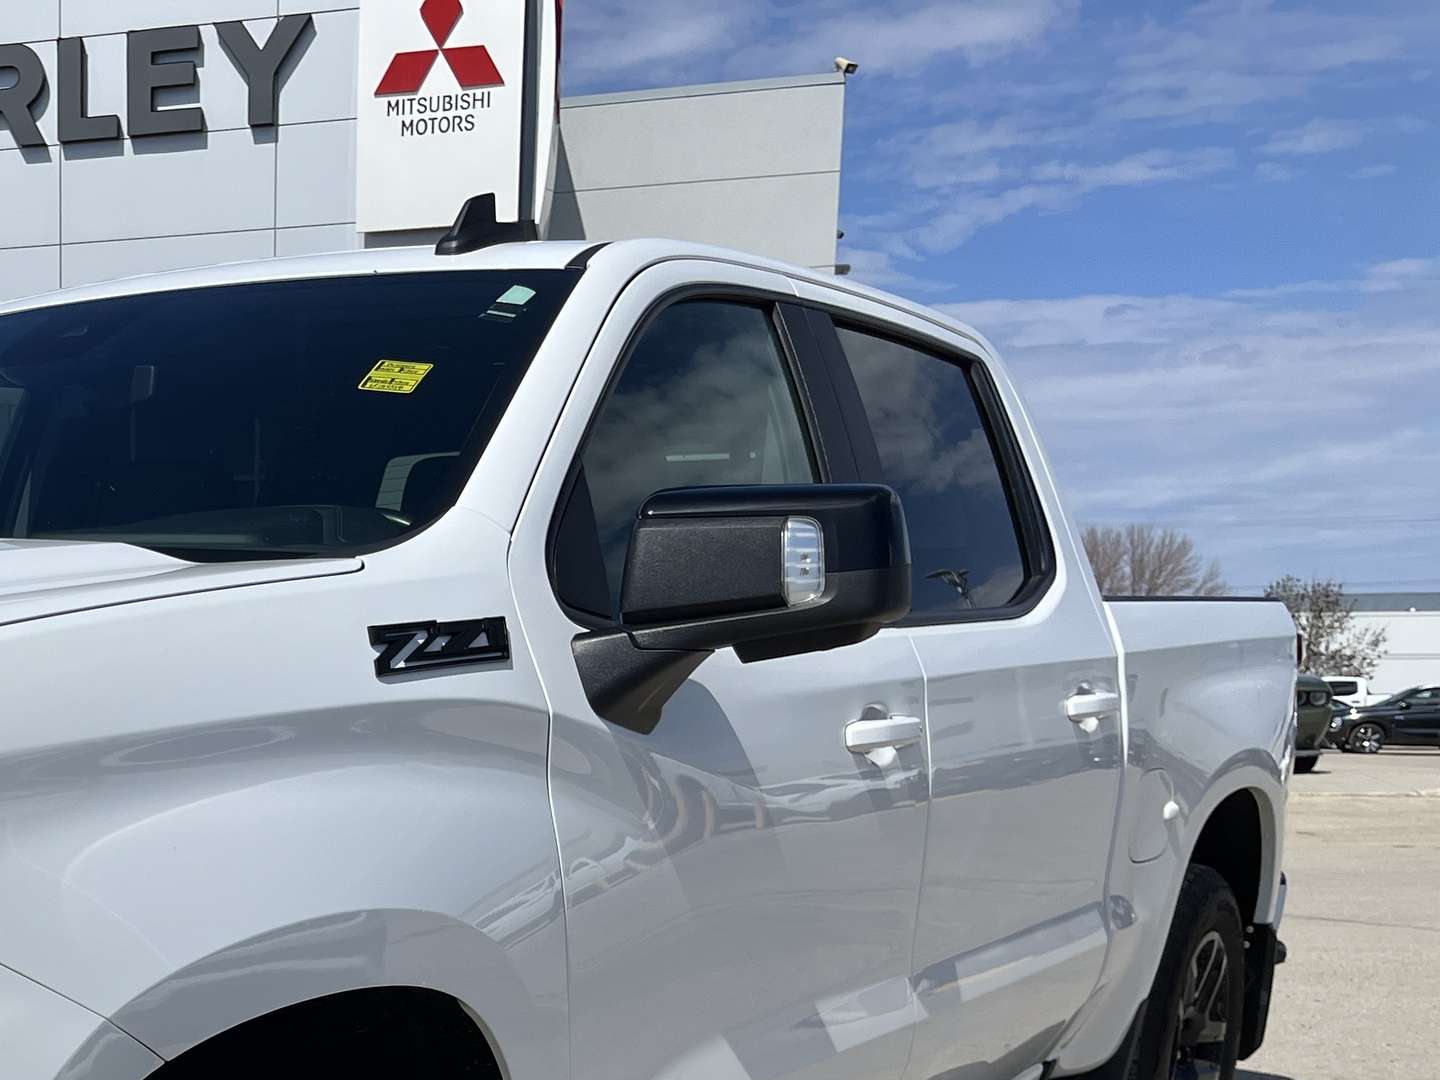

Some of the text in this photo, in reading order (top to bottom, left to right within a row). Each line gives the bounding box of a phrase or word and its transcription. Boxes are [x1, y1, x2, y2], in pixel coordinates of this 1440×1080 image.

[386, 91, 493, 118] MITSUBISHI
[400, 115, 475, 137] MOTORS
[367, 616, 509, 677] Z71
